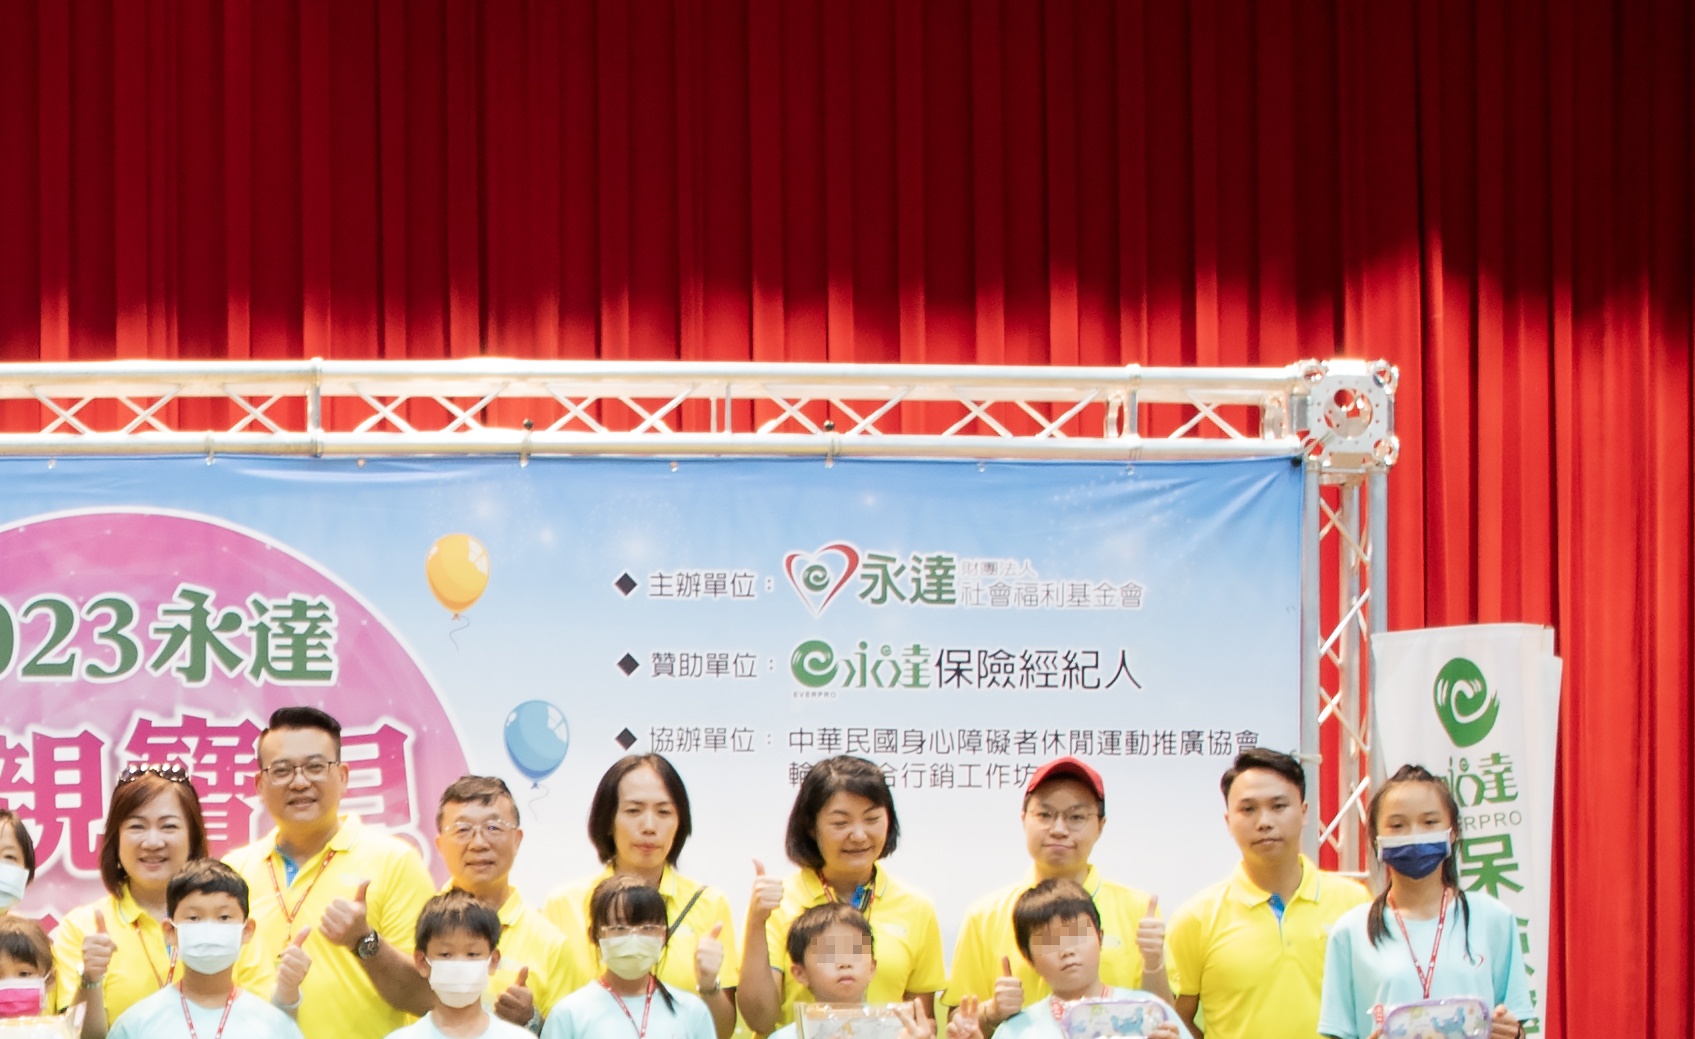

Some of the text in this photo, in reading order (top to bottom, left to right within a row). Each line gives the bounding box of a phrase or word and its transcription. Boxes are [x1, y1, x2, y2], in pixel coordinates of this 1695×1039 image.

[859, 553, 957, 605] 永達
[961, 581, 1144, 608] 社會福利基金會
[789, 762, 1038, 790] 輪合行銷工作坊
